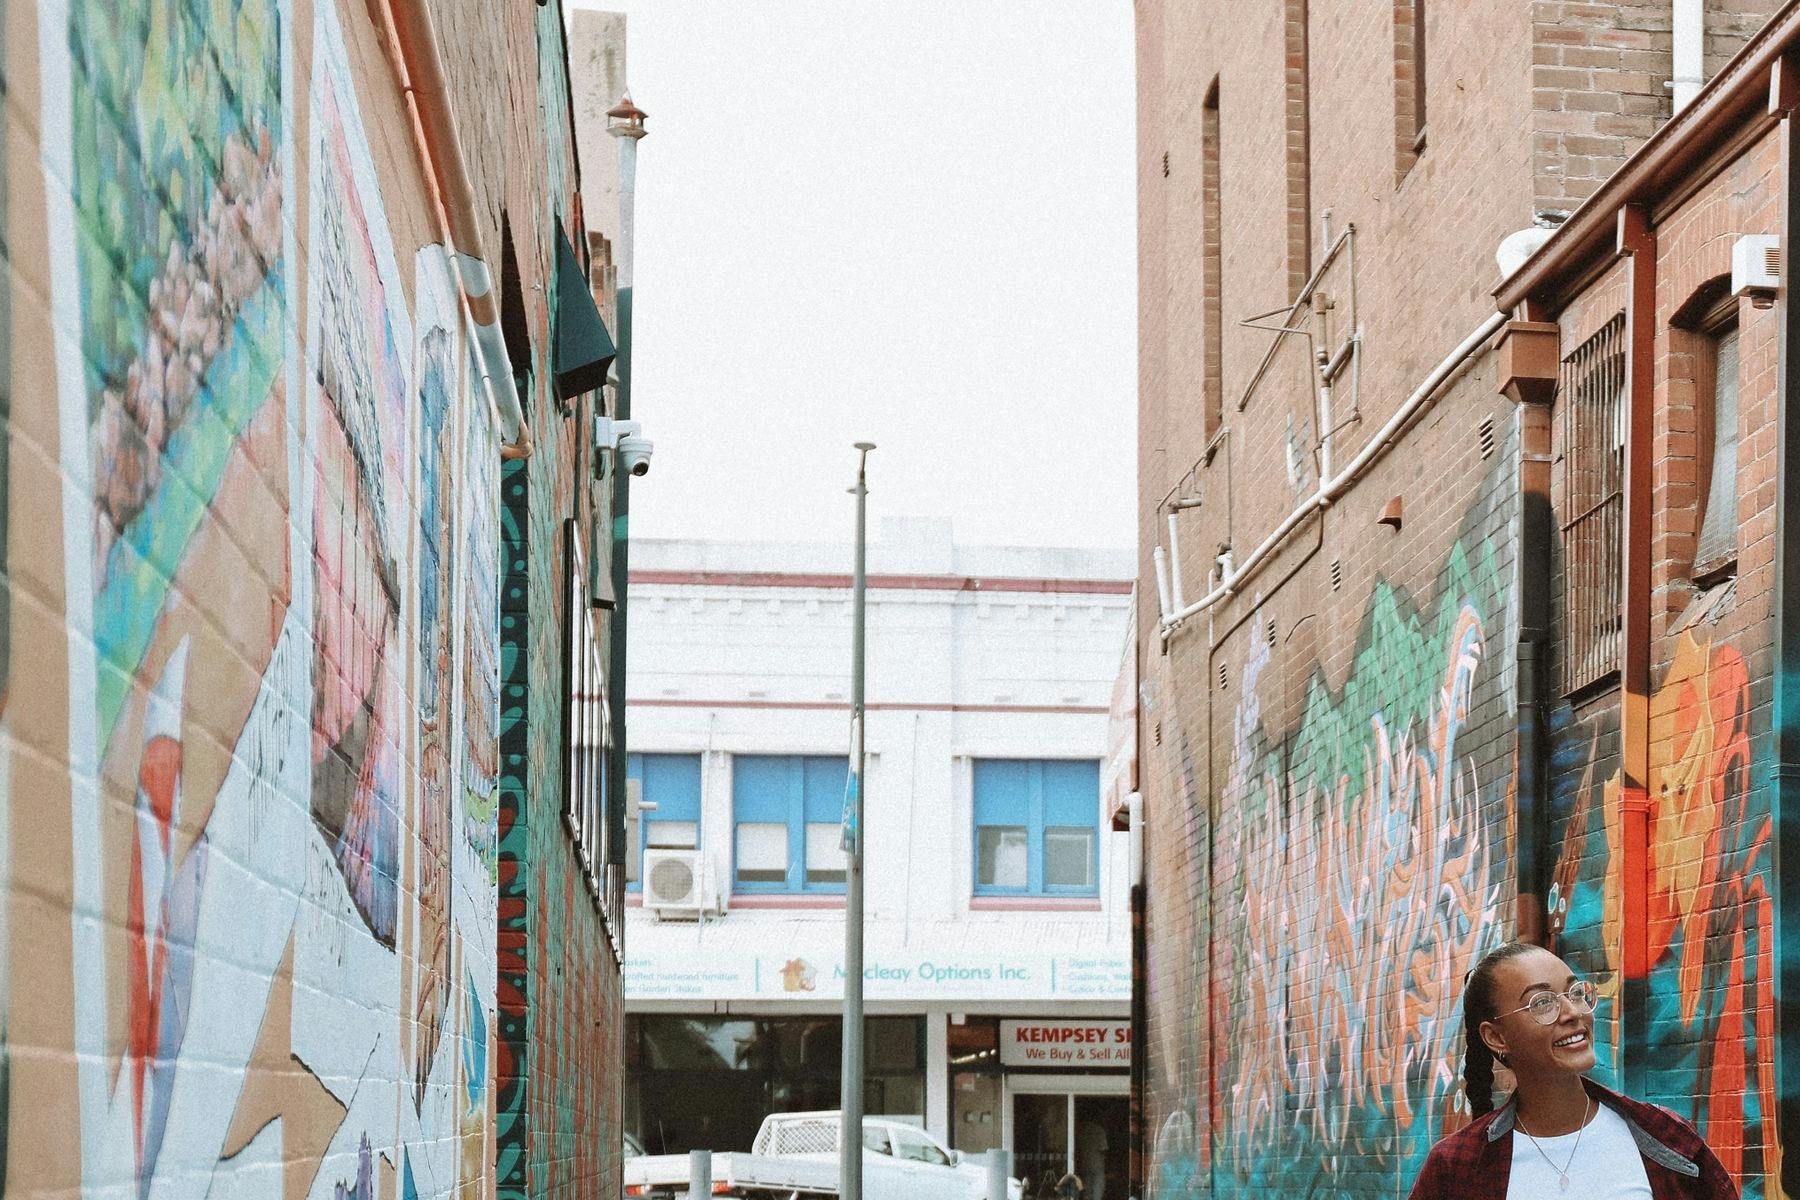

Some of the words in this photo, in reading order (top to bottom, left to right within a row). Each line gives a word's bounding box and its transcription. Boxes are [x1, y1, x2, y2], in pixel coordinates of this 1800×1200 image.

[832, 963, 911, 983] Mcleay
[918, 962, 992, 983] Options
[999, 963, 1031, 980] Inc.
[1016, 1027, 1108, 1043] KEMPSEY
[1026, 1048, 1045, 1059] We
[1050, 1048, 1073, 1062] Buy
[1077, 1048, 1085, 1059] &
[1089, 1048, 1110, 1059] Sell
[1114, 1048, 1130, 1059] All
